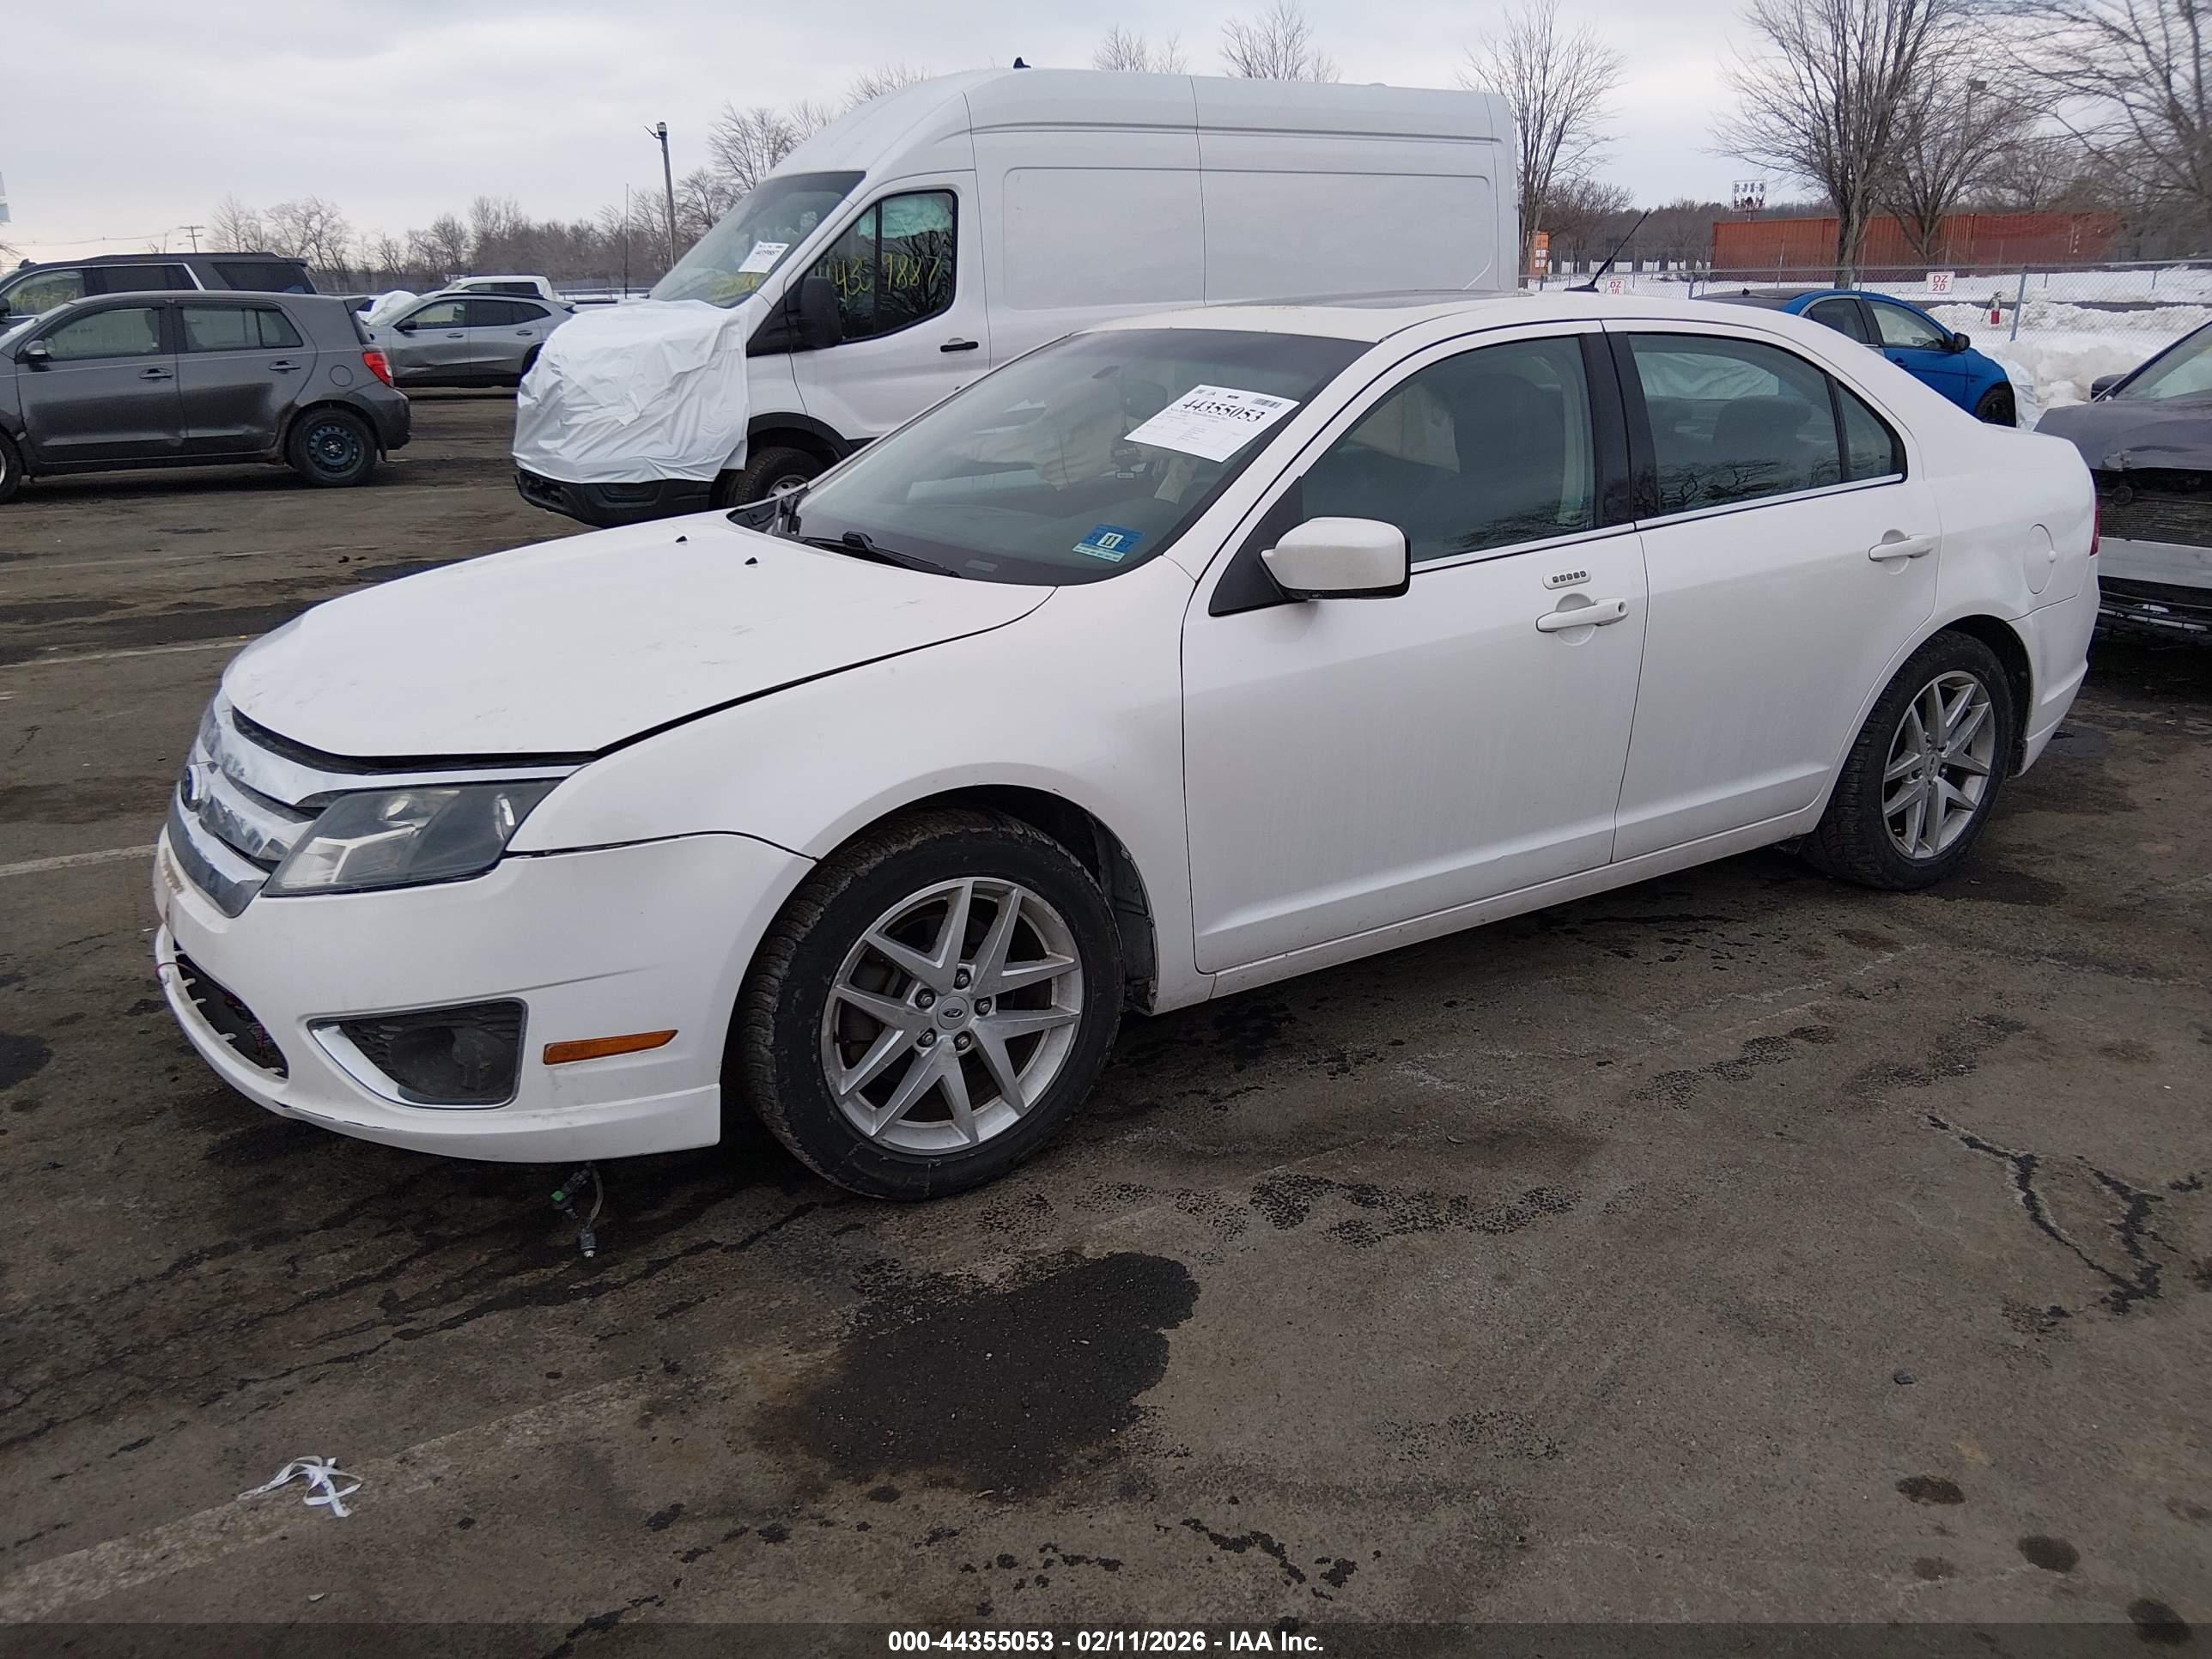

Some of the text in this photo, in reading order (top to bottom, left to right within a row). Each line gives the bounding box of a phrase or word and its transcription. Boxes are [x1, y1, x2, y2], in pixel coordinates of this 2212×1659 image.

[1933, 275, 1948, 283] DZ
[1932, 283, 1946, 292] 20
[1182, 398, 1266, 422] 44355053
[1100, 534, 1118, 548] 11
